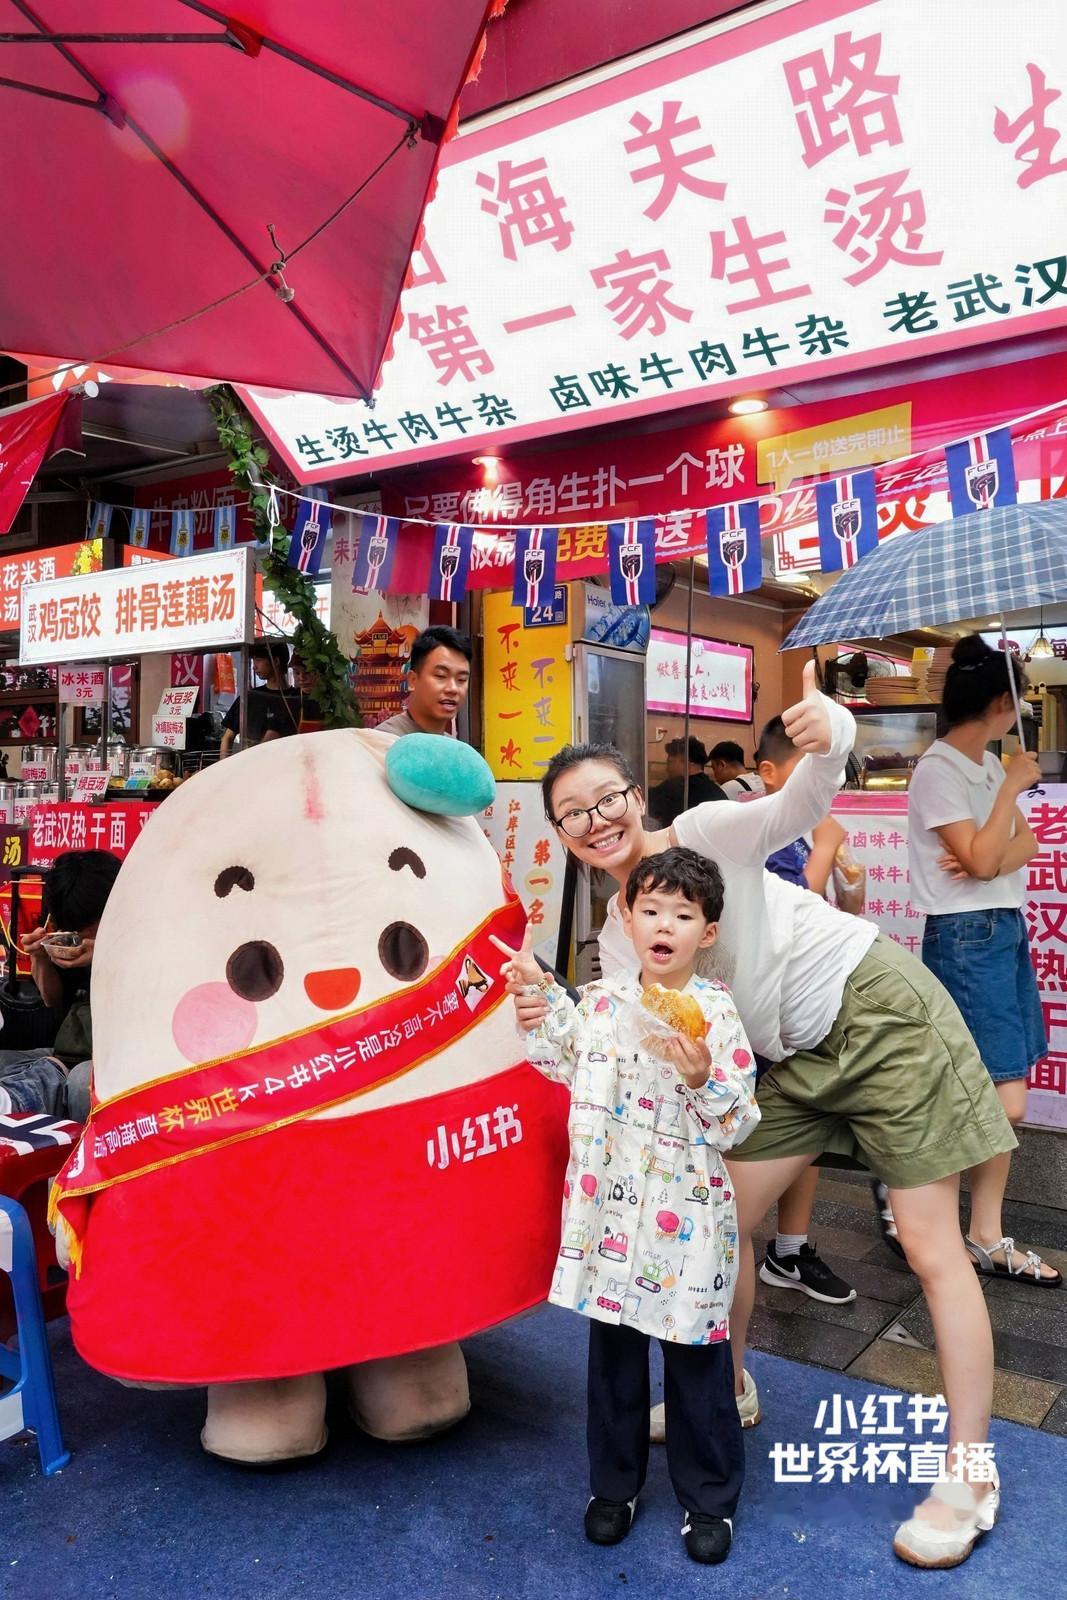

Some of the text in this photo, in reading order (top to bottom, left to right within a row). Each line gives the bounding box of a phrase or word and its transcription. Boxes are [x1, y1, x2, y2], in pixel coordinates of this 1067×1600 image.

[407, 168, 945, 388] 第一家生烫
[295, 255, 1067, 466] 生烫牛肉牛杂 卤味牛肉牛杂 老武汉
[967, 461, 994, 476] FCF
[400, 443, 745, 530] 只要佛得角生扑一个球
[833, 500, 857, 513] FCF
[721, 529, 744, 539] FCF
[443, 546, 459, 554] FCF
[525, 551, 544, 559] FCF
[620, 545, 641, 554] FCF
[0, 556, 56, 591] 花米酒
[28, 572, 236, 643] 武汉 鸡冠饺 排骨莲藕汤
[587, 594, 606, 609] Haier
[61, 671, 104, 686] 冰米酒
[76, 688, 93, 698] 3元
[163, 691, 194, 705] 冰豆浆
[169, 706, 182, 715] 3元
[163, 736, 175, 746] 3元
[33, 811, 126, 850] 老武汉热干面
[502, 799, 521, 880] 江岸区牛
[844, 831, 909, 849] 卤味牛
[2, 836, 22, 867] 汤
[527, 838, 551, 925] 第一名
[864, 864, 911, 884] 味牛
[426, 1104, 524, 1170] 小红书
